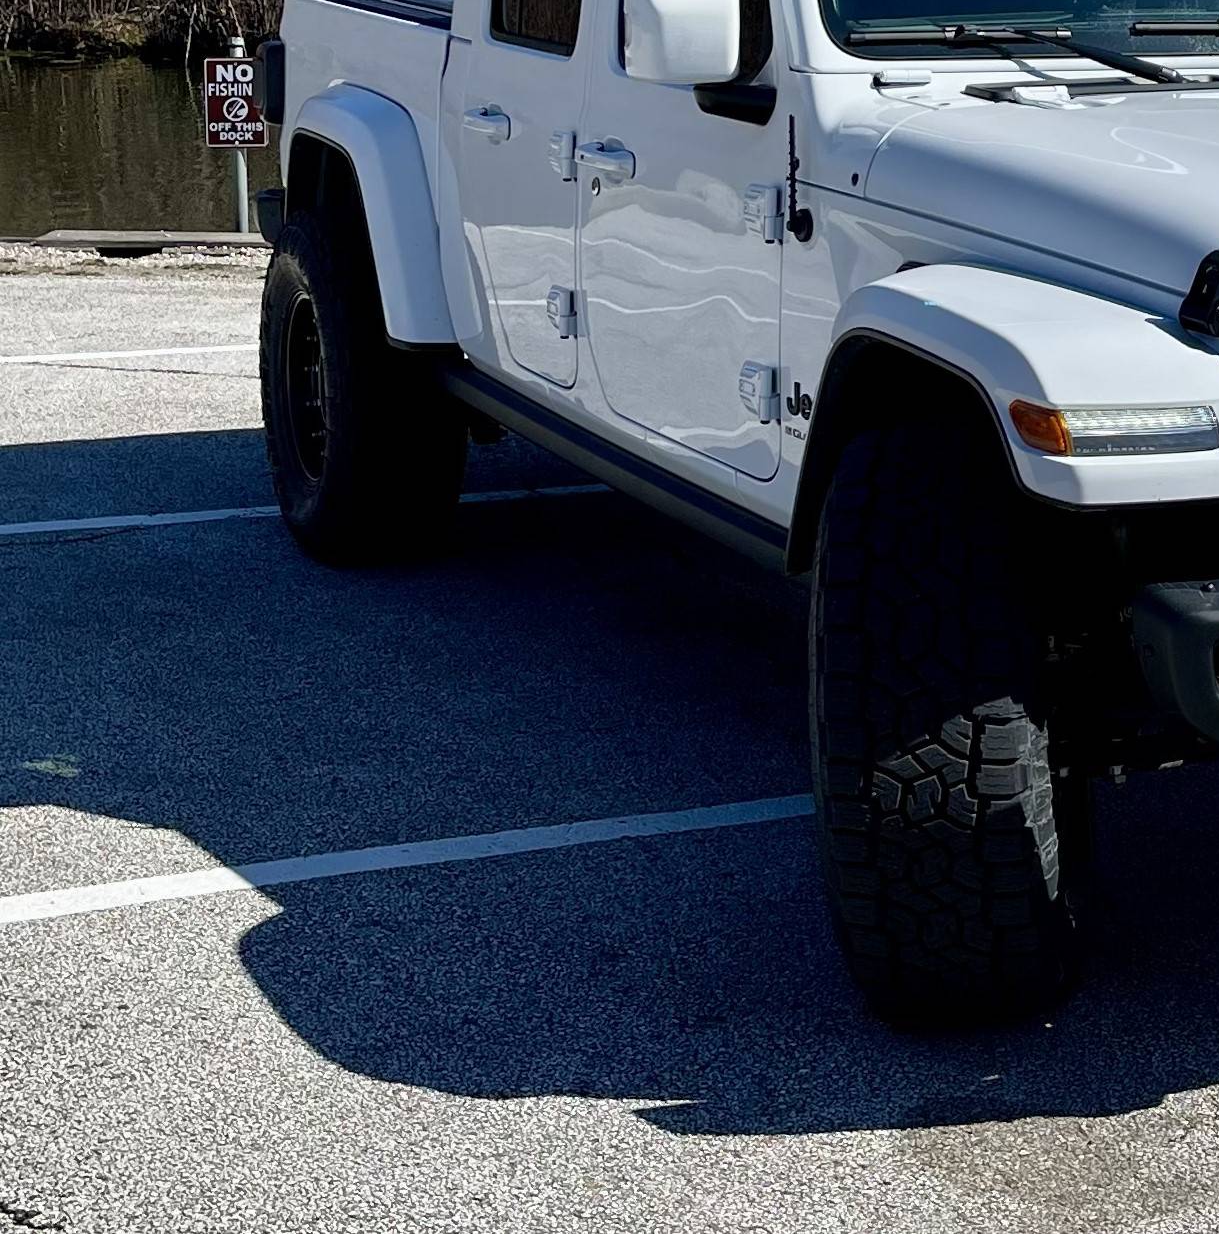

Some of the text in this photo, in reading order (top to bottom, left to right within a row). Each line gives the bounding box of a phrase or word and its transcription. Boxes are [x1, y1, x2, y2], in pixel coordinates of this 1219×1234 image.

[216, 64, 254, 82] NO
[208, 83, 253, 96] FISHIN
[209, 122, 264, 132] OFF THIS
[219, 131, 254, 141] DOCK
[786, 381, 813, 421] Je
